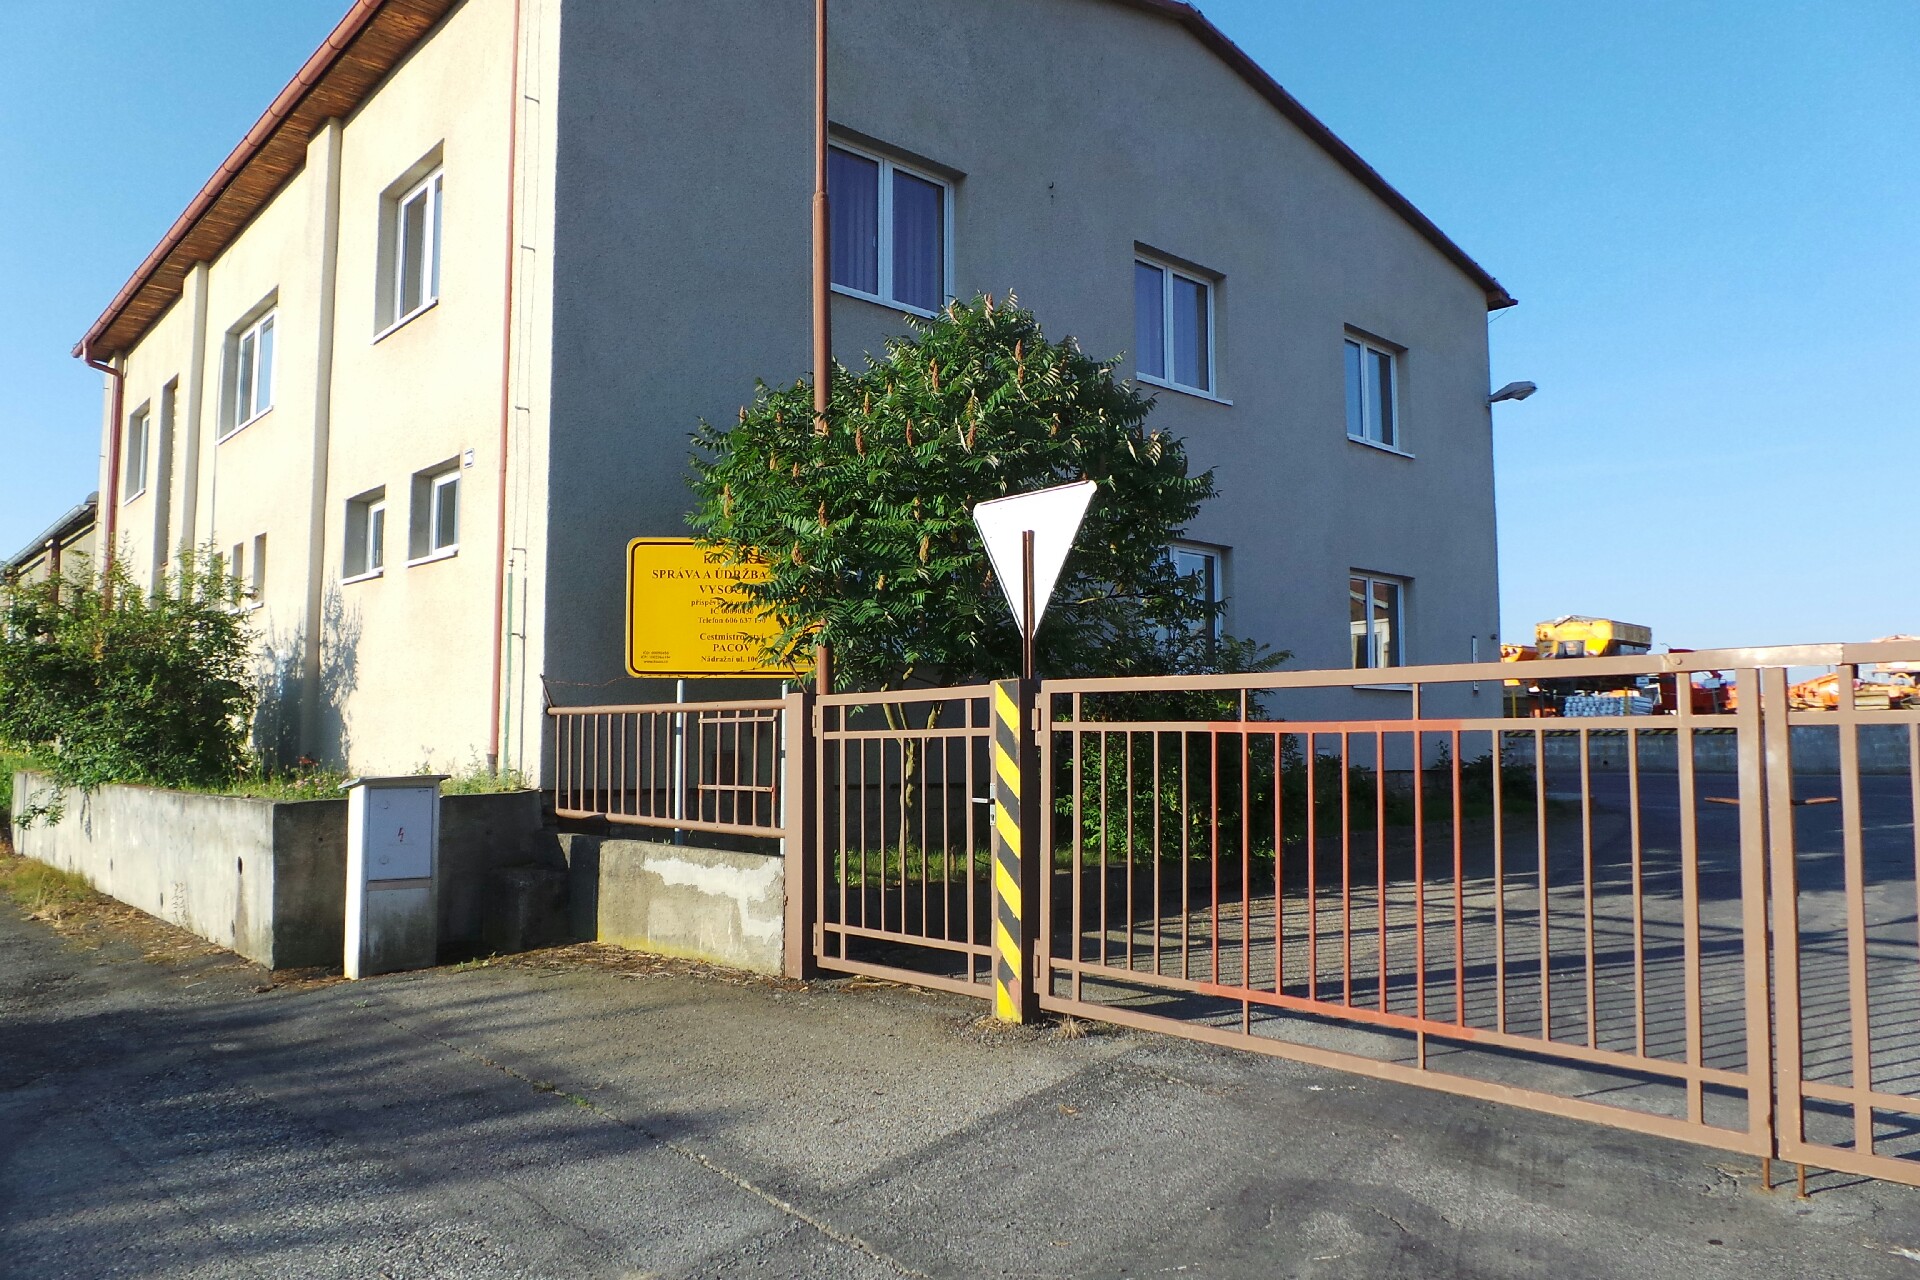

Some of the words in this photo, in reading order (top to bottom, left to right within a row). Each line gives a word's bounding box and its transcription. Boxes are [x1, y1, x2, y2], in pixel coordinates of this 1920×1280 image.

[652, 567, 700, 579] SPRÁVA
[703, 570, 711, 579] A
[715, 567, 766, 579] ÚDRŽBA
[713, 643, 751, 652] PACOV
